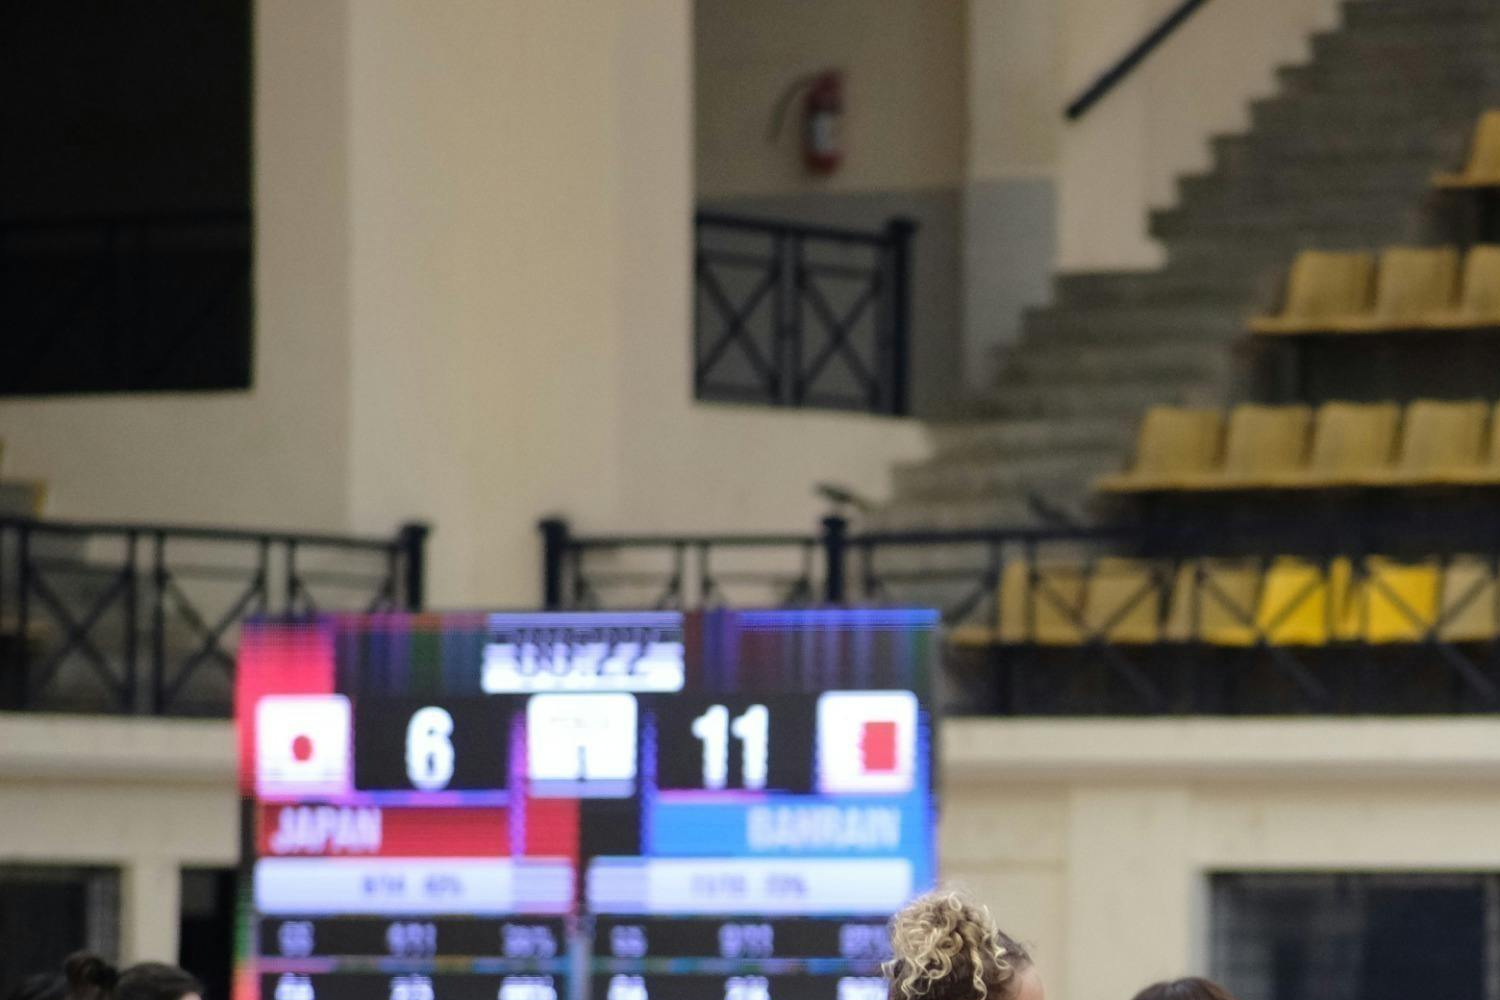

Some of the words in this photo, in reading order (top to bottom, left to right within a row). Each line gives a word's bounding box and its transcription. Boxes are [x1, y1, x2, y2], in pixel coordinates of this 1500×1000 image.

[405, 705, 455, 789] 6
[692, 703, 770, 789] 11
[271, 806, 382, 853] JAPAN
[746, 805, 900, 850] BAHRAIN
